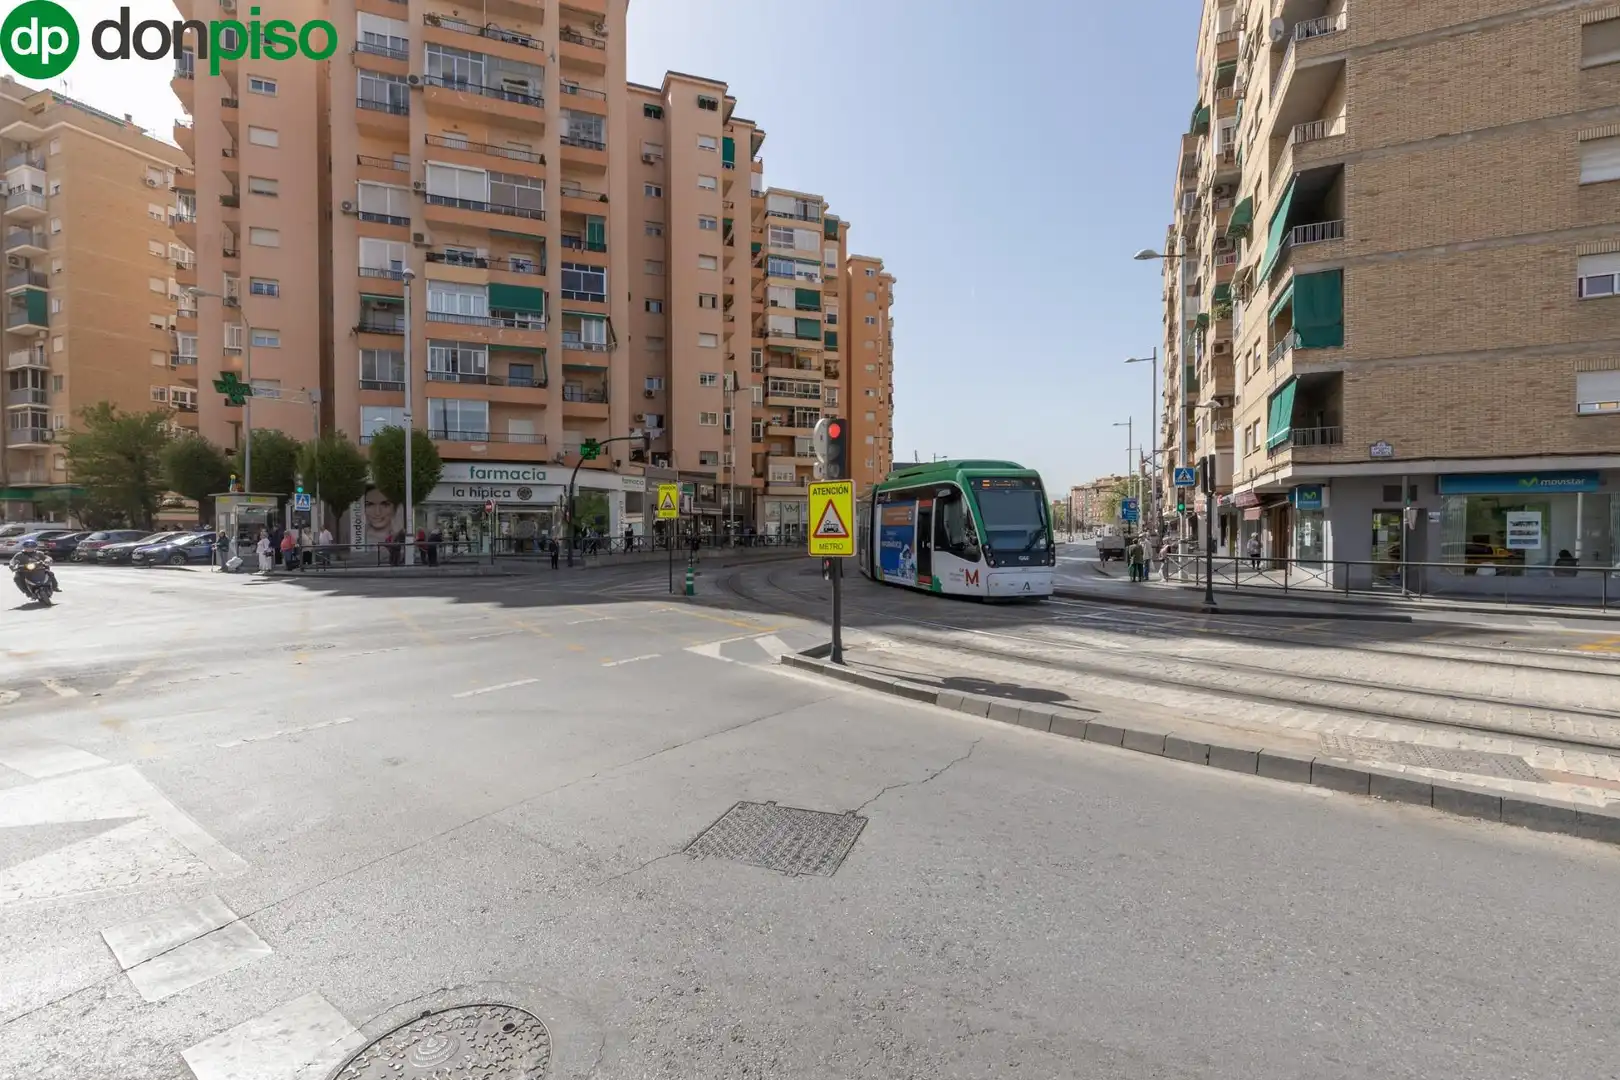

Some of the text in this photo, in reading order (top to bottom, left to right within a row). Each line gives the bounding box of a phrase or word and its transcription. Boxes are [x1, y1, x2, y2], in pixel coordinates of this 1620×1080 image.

[469, 465, 547, 481] farmacia
[1540, 478, 1586, 487] movistar
[452, 486, 511, 499] la hípica
[812, 484, 849, 496] ATENCIÓN
[819, 542, 844, 551] METRO
